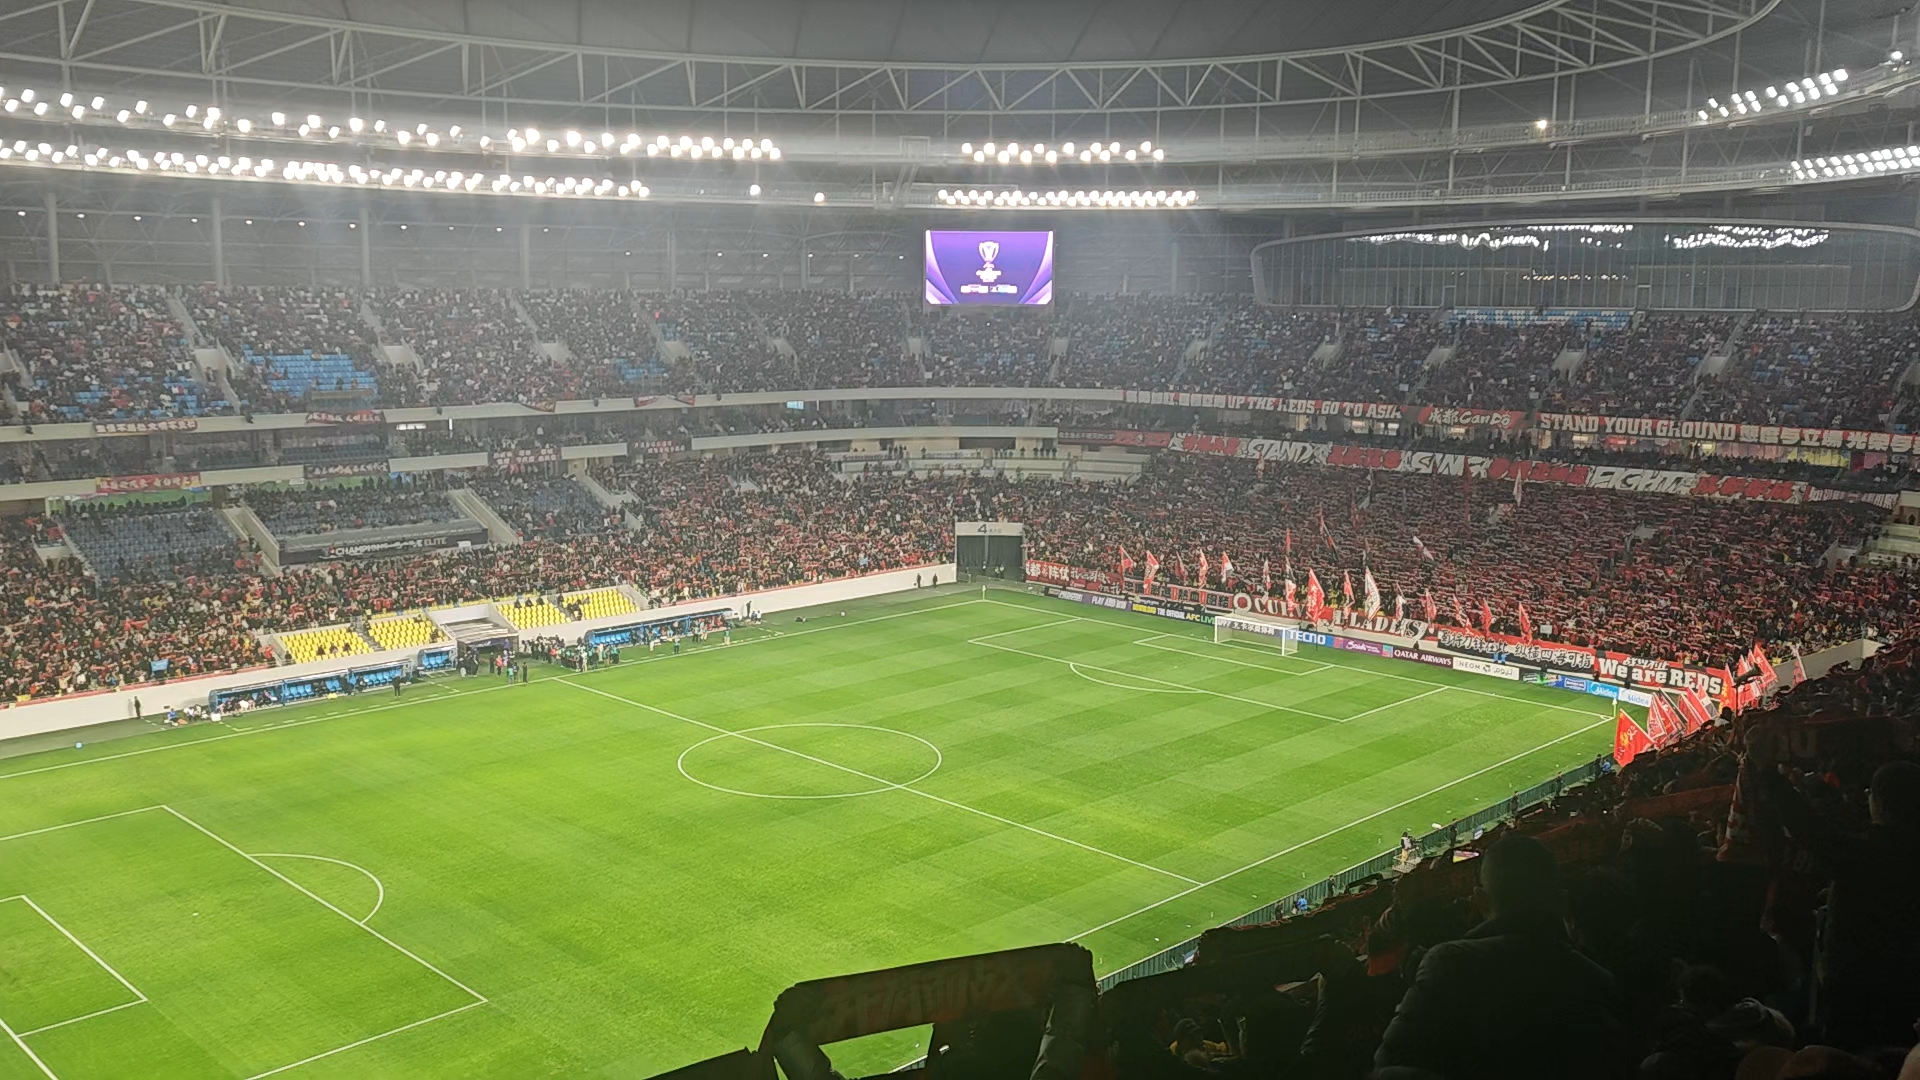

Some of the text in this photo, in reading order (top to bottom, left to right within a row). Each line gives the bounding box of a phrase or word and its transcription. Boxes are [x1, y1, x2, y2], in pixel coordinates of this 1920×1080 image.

[1228, 395, 1245, 409] UP
[1247, 396, 1274, 411] THE
[1321, 401, 1340, 415] GO
[1342, 402, 1363, 417] TO
[1365, 404, 1402, 419] ASIA
[1540, 412, 1736, 440] STAND YOUR GROUND
[1248, 439, 1313, 464] STAND
[1588, 466, 1688, 494] FIGHT
[977, 524, 987, 534] 4
[424, 537, 447, 546] ELITE
[1091, 595, 1105, 606] PLAY
[1255, 597, 1308, 619] CUV
[1157, 607, 1166, 616] THE
[1166, 608, 1185, 620] OFFICIAL
[1186, 612, 1200, 622] AFC
[1200, 615, 1216, 626] LIVE
[1288, 629, 1326, 645] TECNO
[1393, 649, 1419, 660] QATAR
[1420, 653, 1452, 666] AIRWAYS
[1458, 660, 1481, 670] NEOM
[1598, 657, 1628, 679] We
[1631, 667, 1667, 684] are
[1669, 668, 1722, 695] REDS
[1626, 694, 1650, 705] Midea
